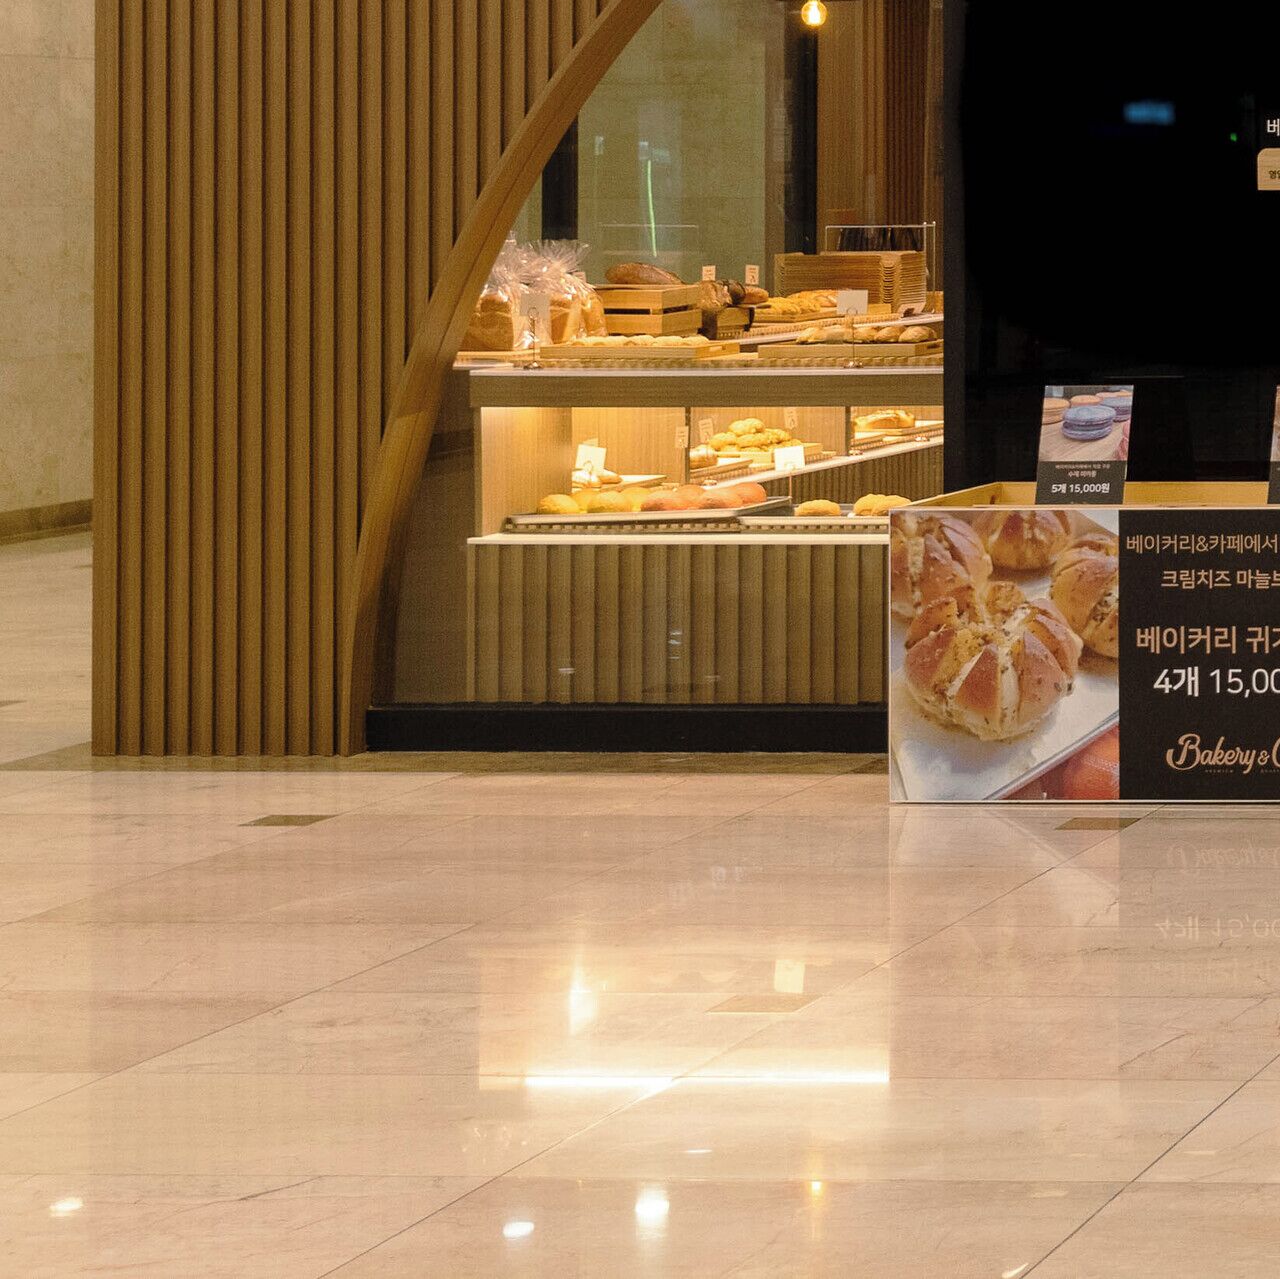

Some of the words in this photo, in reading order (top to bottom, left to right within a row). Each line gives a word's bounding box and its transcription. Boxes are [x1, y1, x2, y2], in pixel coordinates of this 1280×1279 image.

[1051, 482, 1067, 494] 5개
[1069, 482, 1110, 494] 15,000원
[1126, 533, 1279, 554] 베이커리&카페에서
[1160, 568, 1232, 589] 크림치즈
[1136, 625, 1237, 655] 베이커리
[1152, 666, 1200, 698] 4개
[1165, 731, 1256, 775] Bakery
